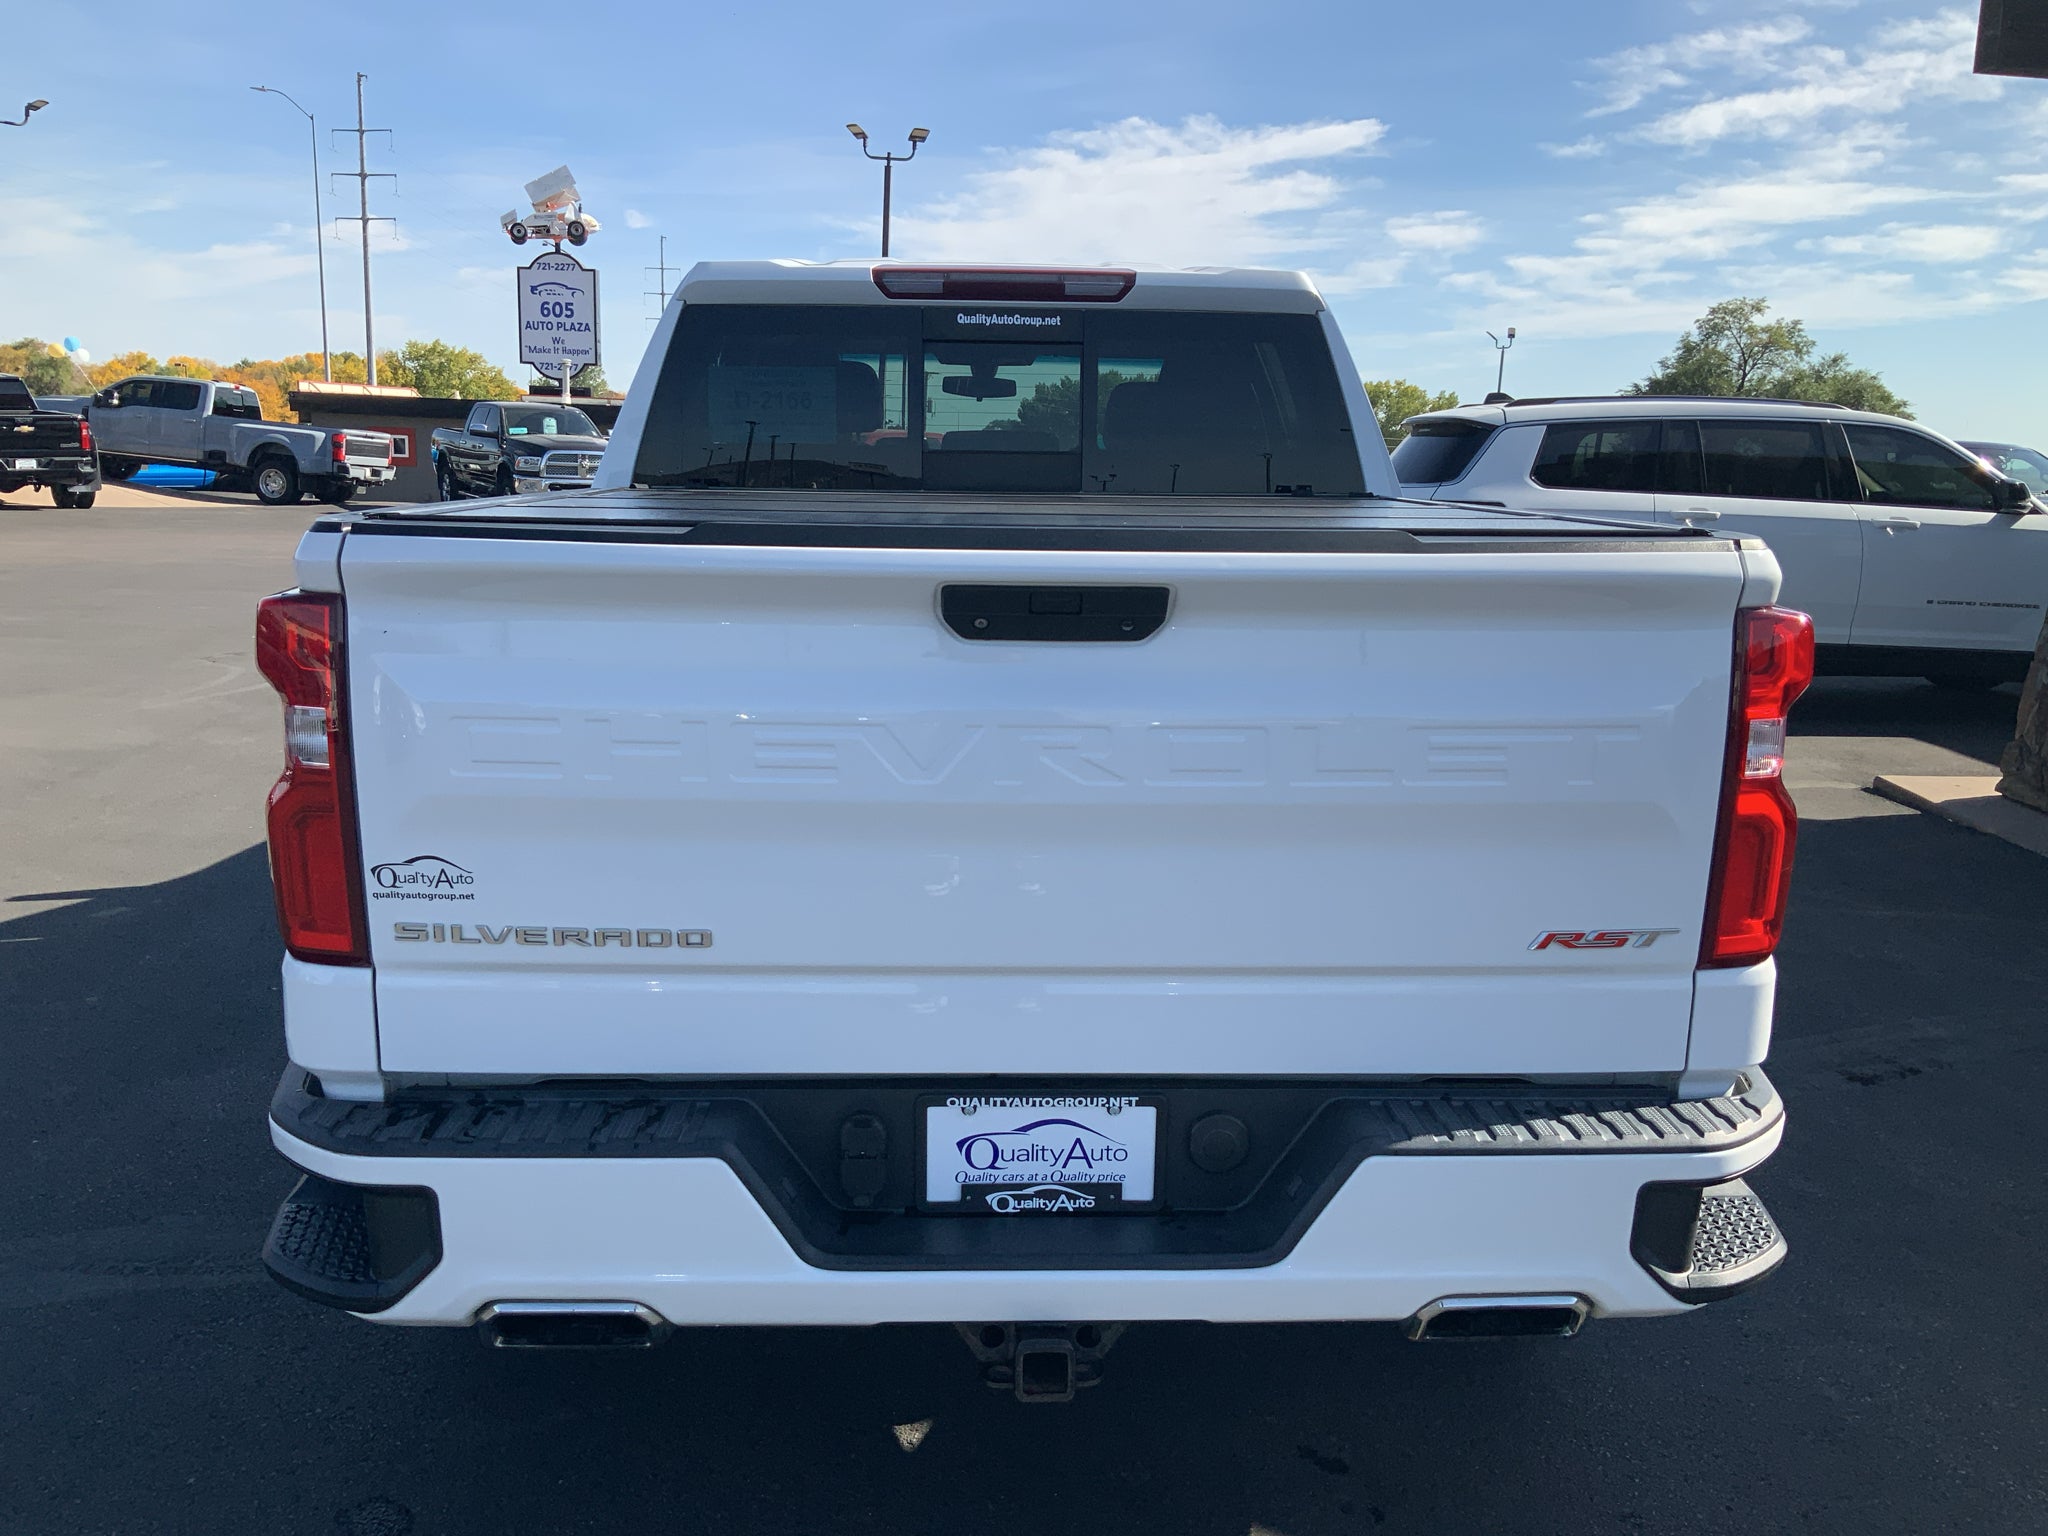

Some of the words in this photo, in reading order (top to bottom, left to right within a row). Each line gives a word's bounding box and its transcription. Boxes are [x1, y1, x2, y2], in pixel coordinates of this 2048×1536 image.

[536, 262, 576, 272] 721-2277
[540, 301, 575, 319] 605
[525, 320, 554, 331] AUTO
[556, 321, 592, 333] PLAZA
[957, 313, 1062, 327] QualityAutoGroup.net
[551, 336, 566, 345] We
[553, 346, 560, 355] It
[539, 362, 579, 372] 721-277
[449, 715, 1642, 787] CHEVROLET
[376, 866, 474, 889] QualtyAuto
[372, 891, 475, 902] qualityautogroup.net
[394, 921, 713, 948] SILVERADO
[1527, 928, 1680, 950] RST
[946, 1096, 1139, 1108] QUALITYAUTOGROUP.NET
[954, 1170, 1000, 1184] Quality
[1002, 1173, 1025, 1182] cars
[1027, 1172, 1039, 1182] at
[1041, 1174, 1048, 1182] a
[1050, 1169, 1095, 1184] Quality
[1097, 1172, 1126, 1184] price
